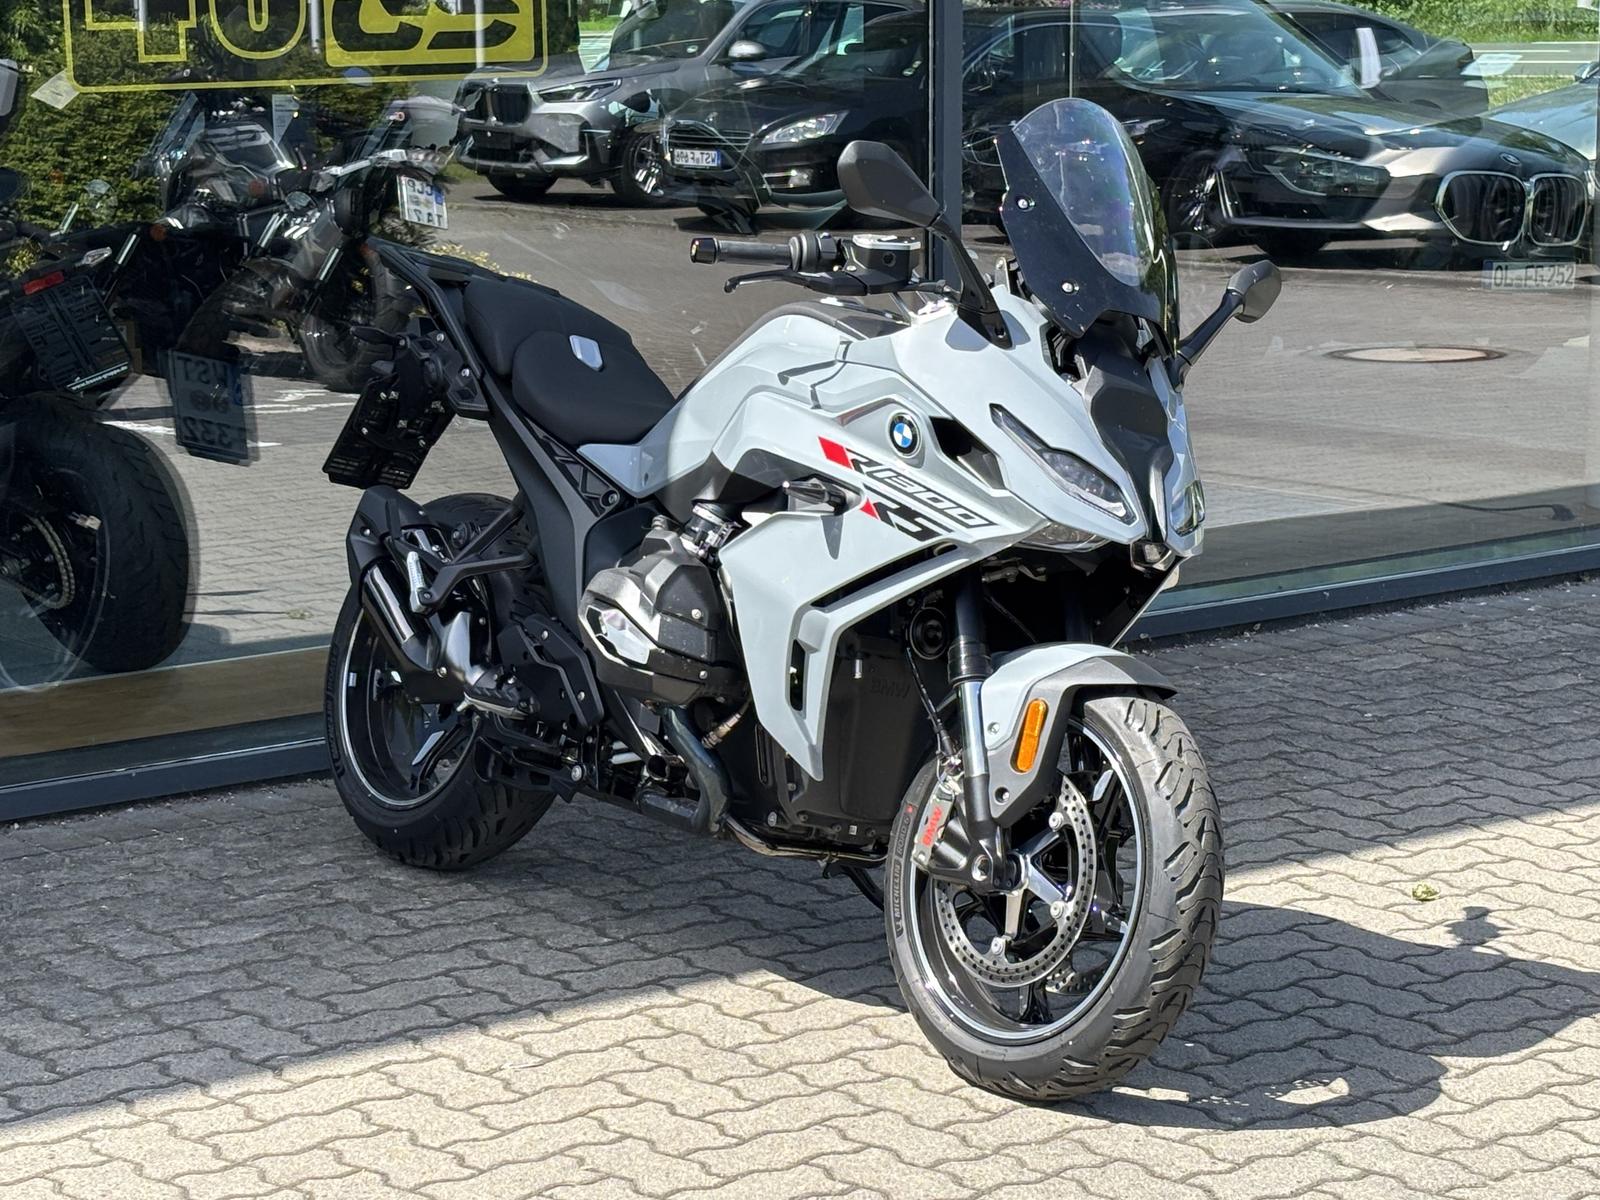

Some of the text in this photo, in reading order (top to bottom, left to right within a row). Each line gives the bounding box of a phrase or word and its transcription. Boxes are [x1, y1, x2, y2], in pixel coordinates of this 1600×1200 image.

[1494, 264, 1514, 287] OL
[1547, 264, 1575, 286] 252
[922, 806, 943, 847] BMW
[892, 862, 902, 918] MICHELIN
